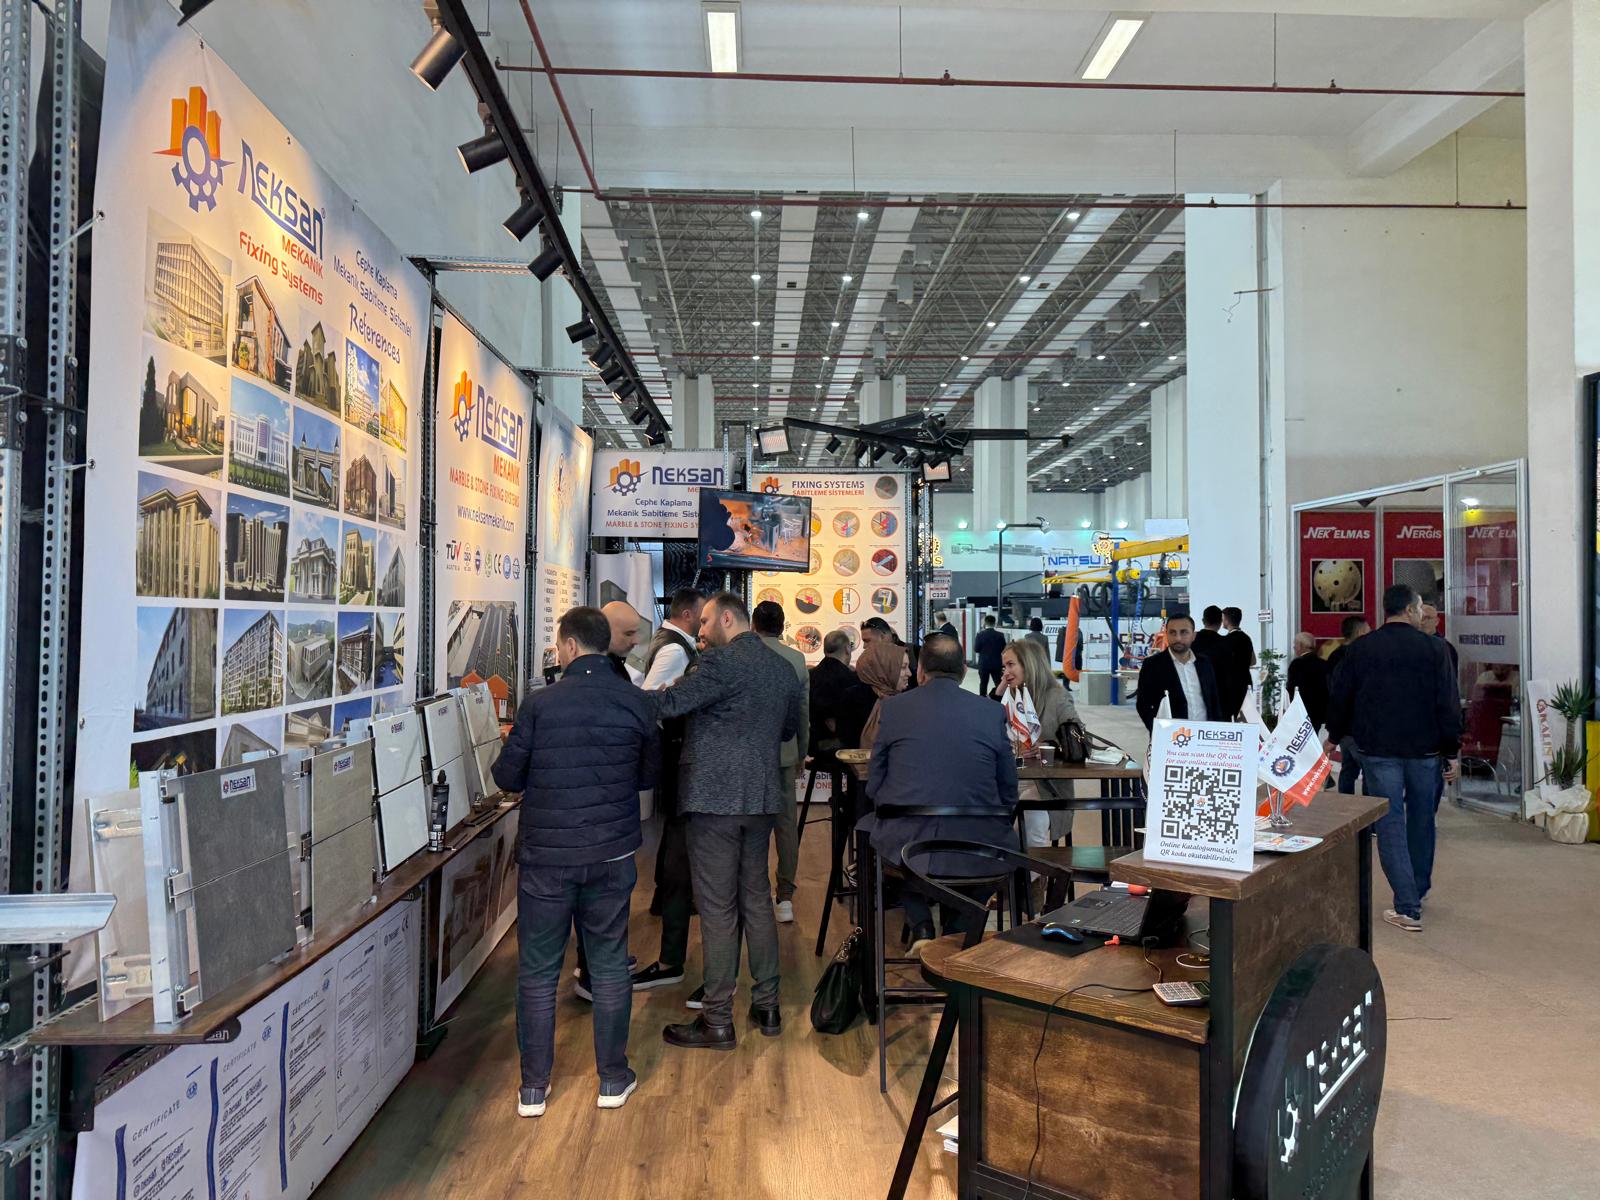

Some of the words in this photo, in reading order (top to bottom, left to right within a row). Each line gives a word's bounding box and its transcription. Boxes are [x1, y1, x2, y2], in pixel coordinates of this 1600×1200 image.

[239, 231, 279, 275] Fixing
[281, 261, 324, 305] Systems
[333, 255, 360, 291] Mekanik
[355, 250, 374, 278] Cephe
[374, 267, 398, 301] Kaplama
[349, 302, 401, 364] References
[449, 466, 470, 489] MARBLE
[475, 476, 489, 497] STONE
[791, 480, 822, 489] FIXING
[824, 480, 865, 489] SYSTEMS
[635, 498, 658, 507] Cephe
[660, 498, 693, 508] Kaplama
[607, 509, 639, 517] Mekanik
[641, 509, 679, 518] Sabitleme
[640, 521, 662, 529] STONE
[664, 521, 689, 529] FIXING
[1303, 526, 1335, 539] NEK
[1333, 529, 1371, 539] ELMAS
[1468, 526, 1499, 539] NEK
[1048, 555, 1101, 566] NATSU
[1188, 758, 1209, 766] online
[1217, 752, 1228, 760] QR
[1160, 840, 1181, 848] Online
[1225, 847, 1238, 855] için
[1160, 848, 1170, 857] QR
[132, 1099, 181, 1142] CERTIFICATE
